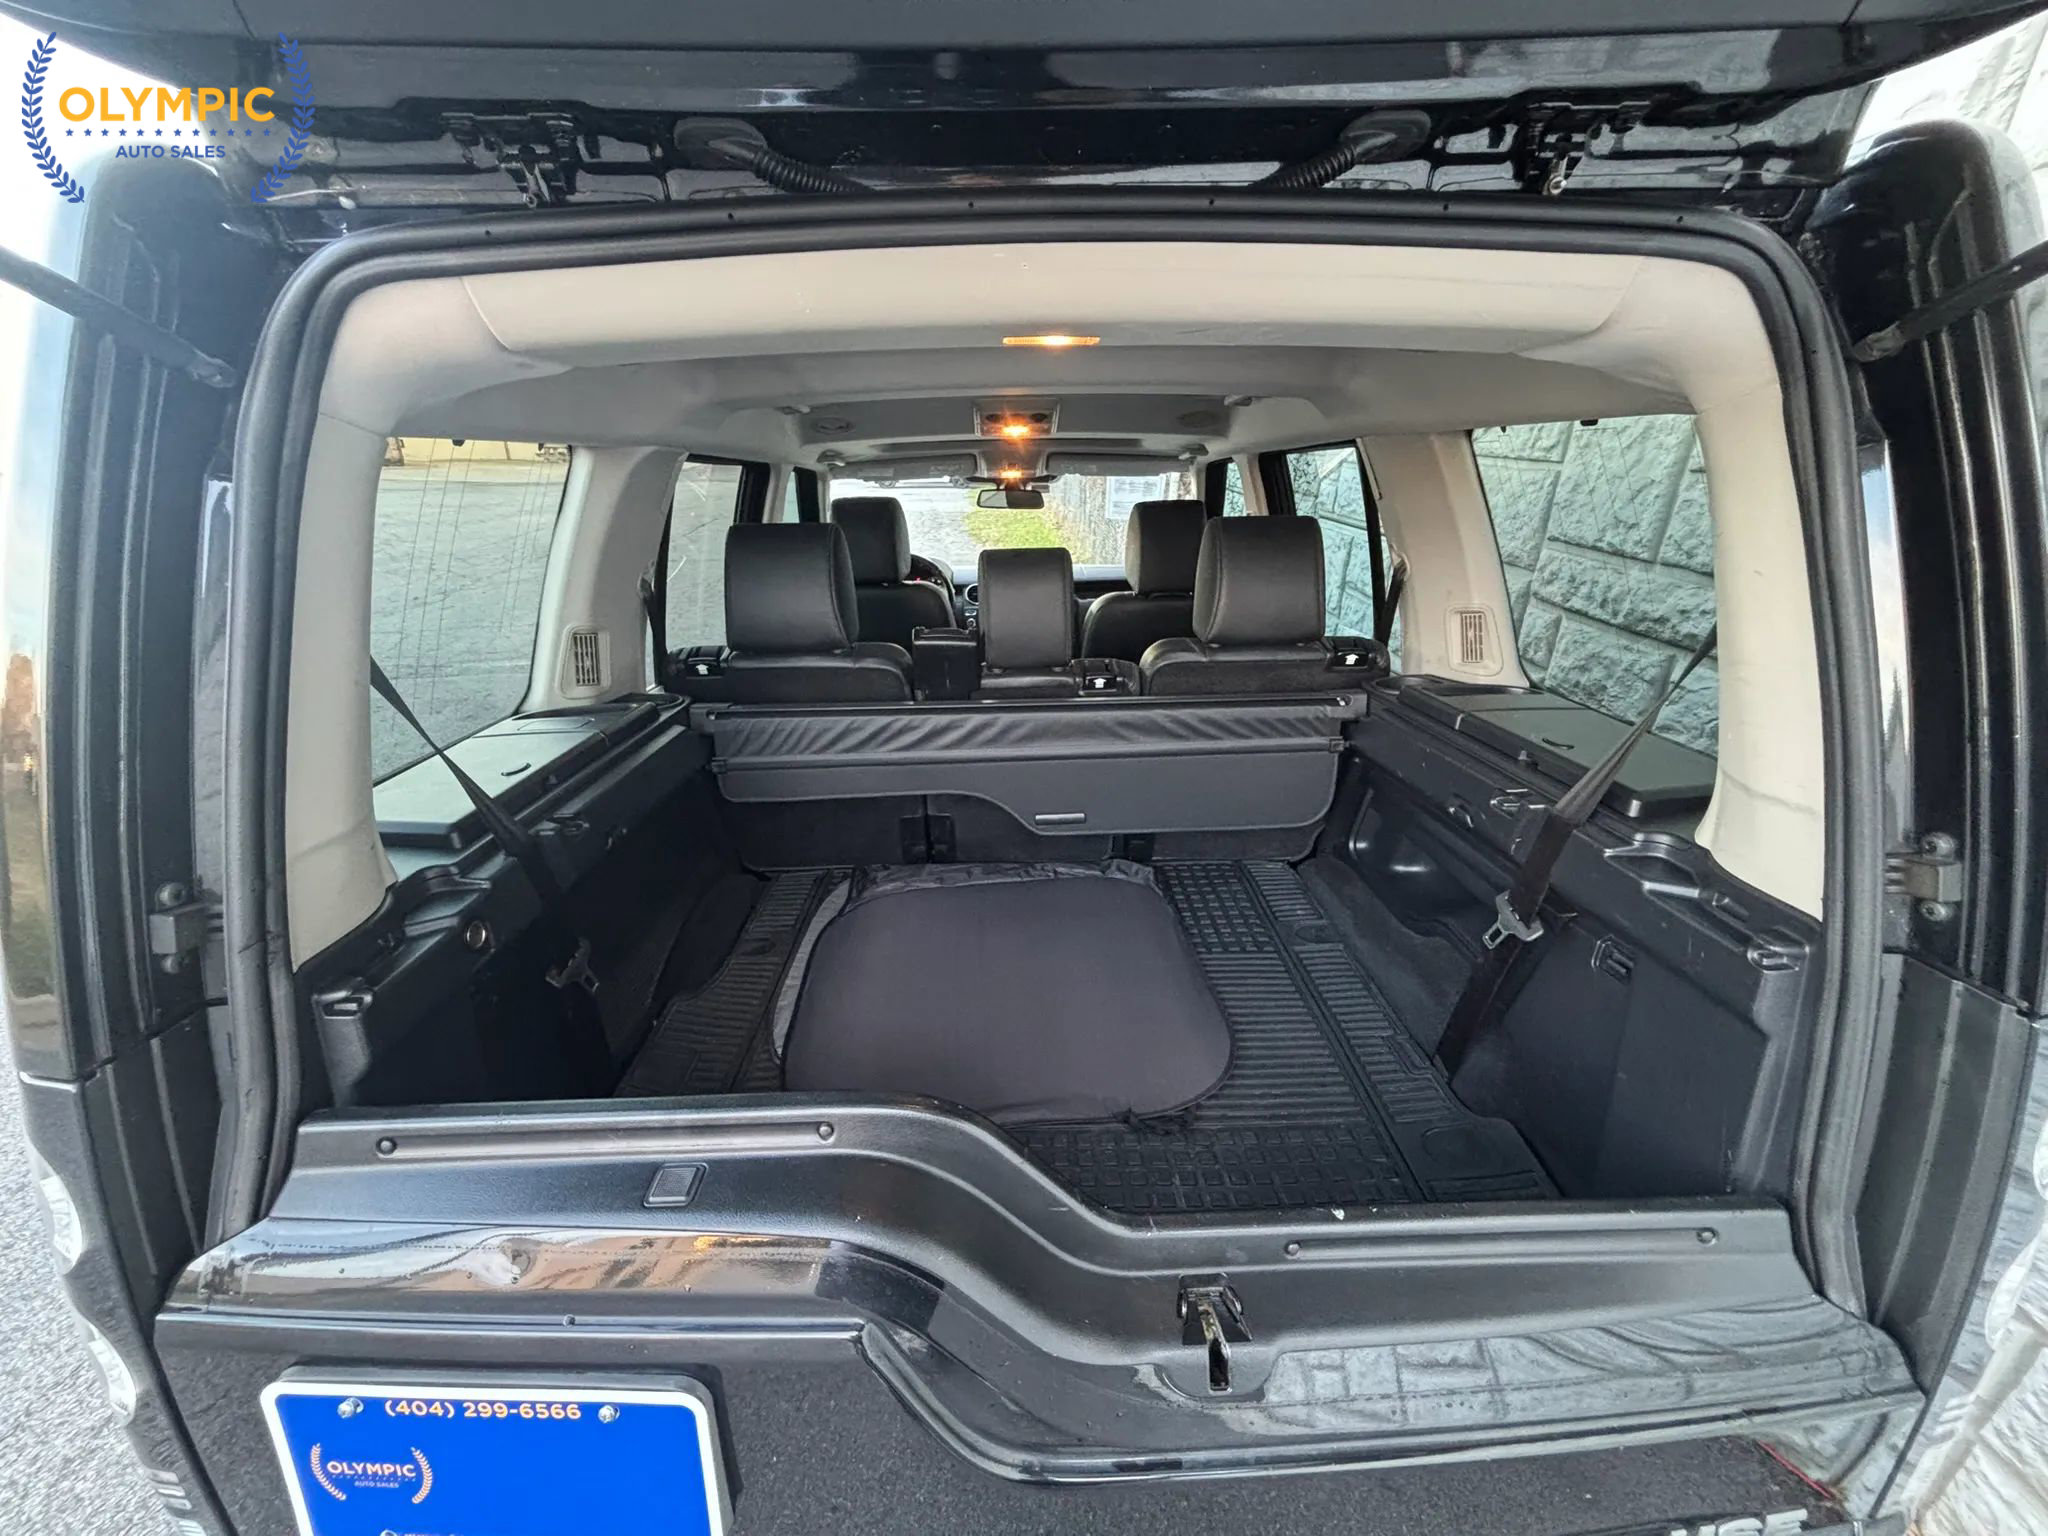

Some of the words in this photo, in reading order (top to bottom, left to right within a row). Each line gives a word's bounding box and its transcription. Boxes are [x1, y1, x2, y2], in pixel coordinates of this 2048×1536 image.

[384, 1400, 455, 1419] (404)
[462, 1402, 582, 1420] 299-6566
[326, 1460, 416, 1477] OLYMPIC
[354, 1480, 375, 1488] AUTO
[376, 1481, 400, 1489] SALES
